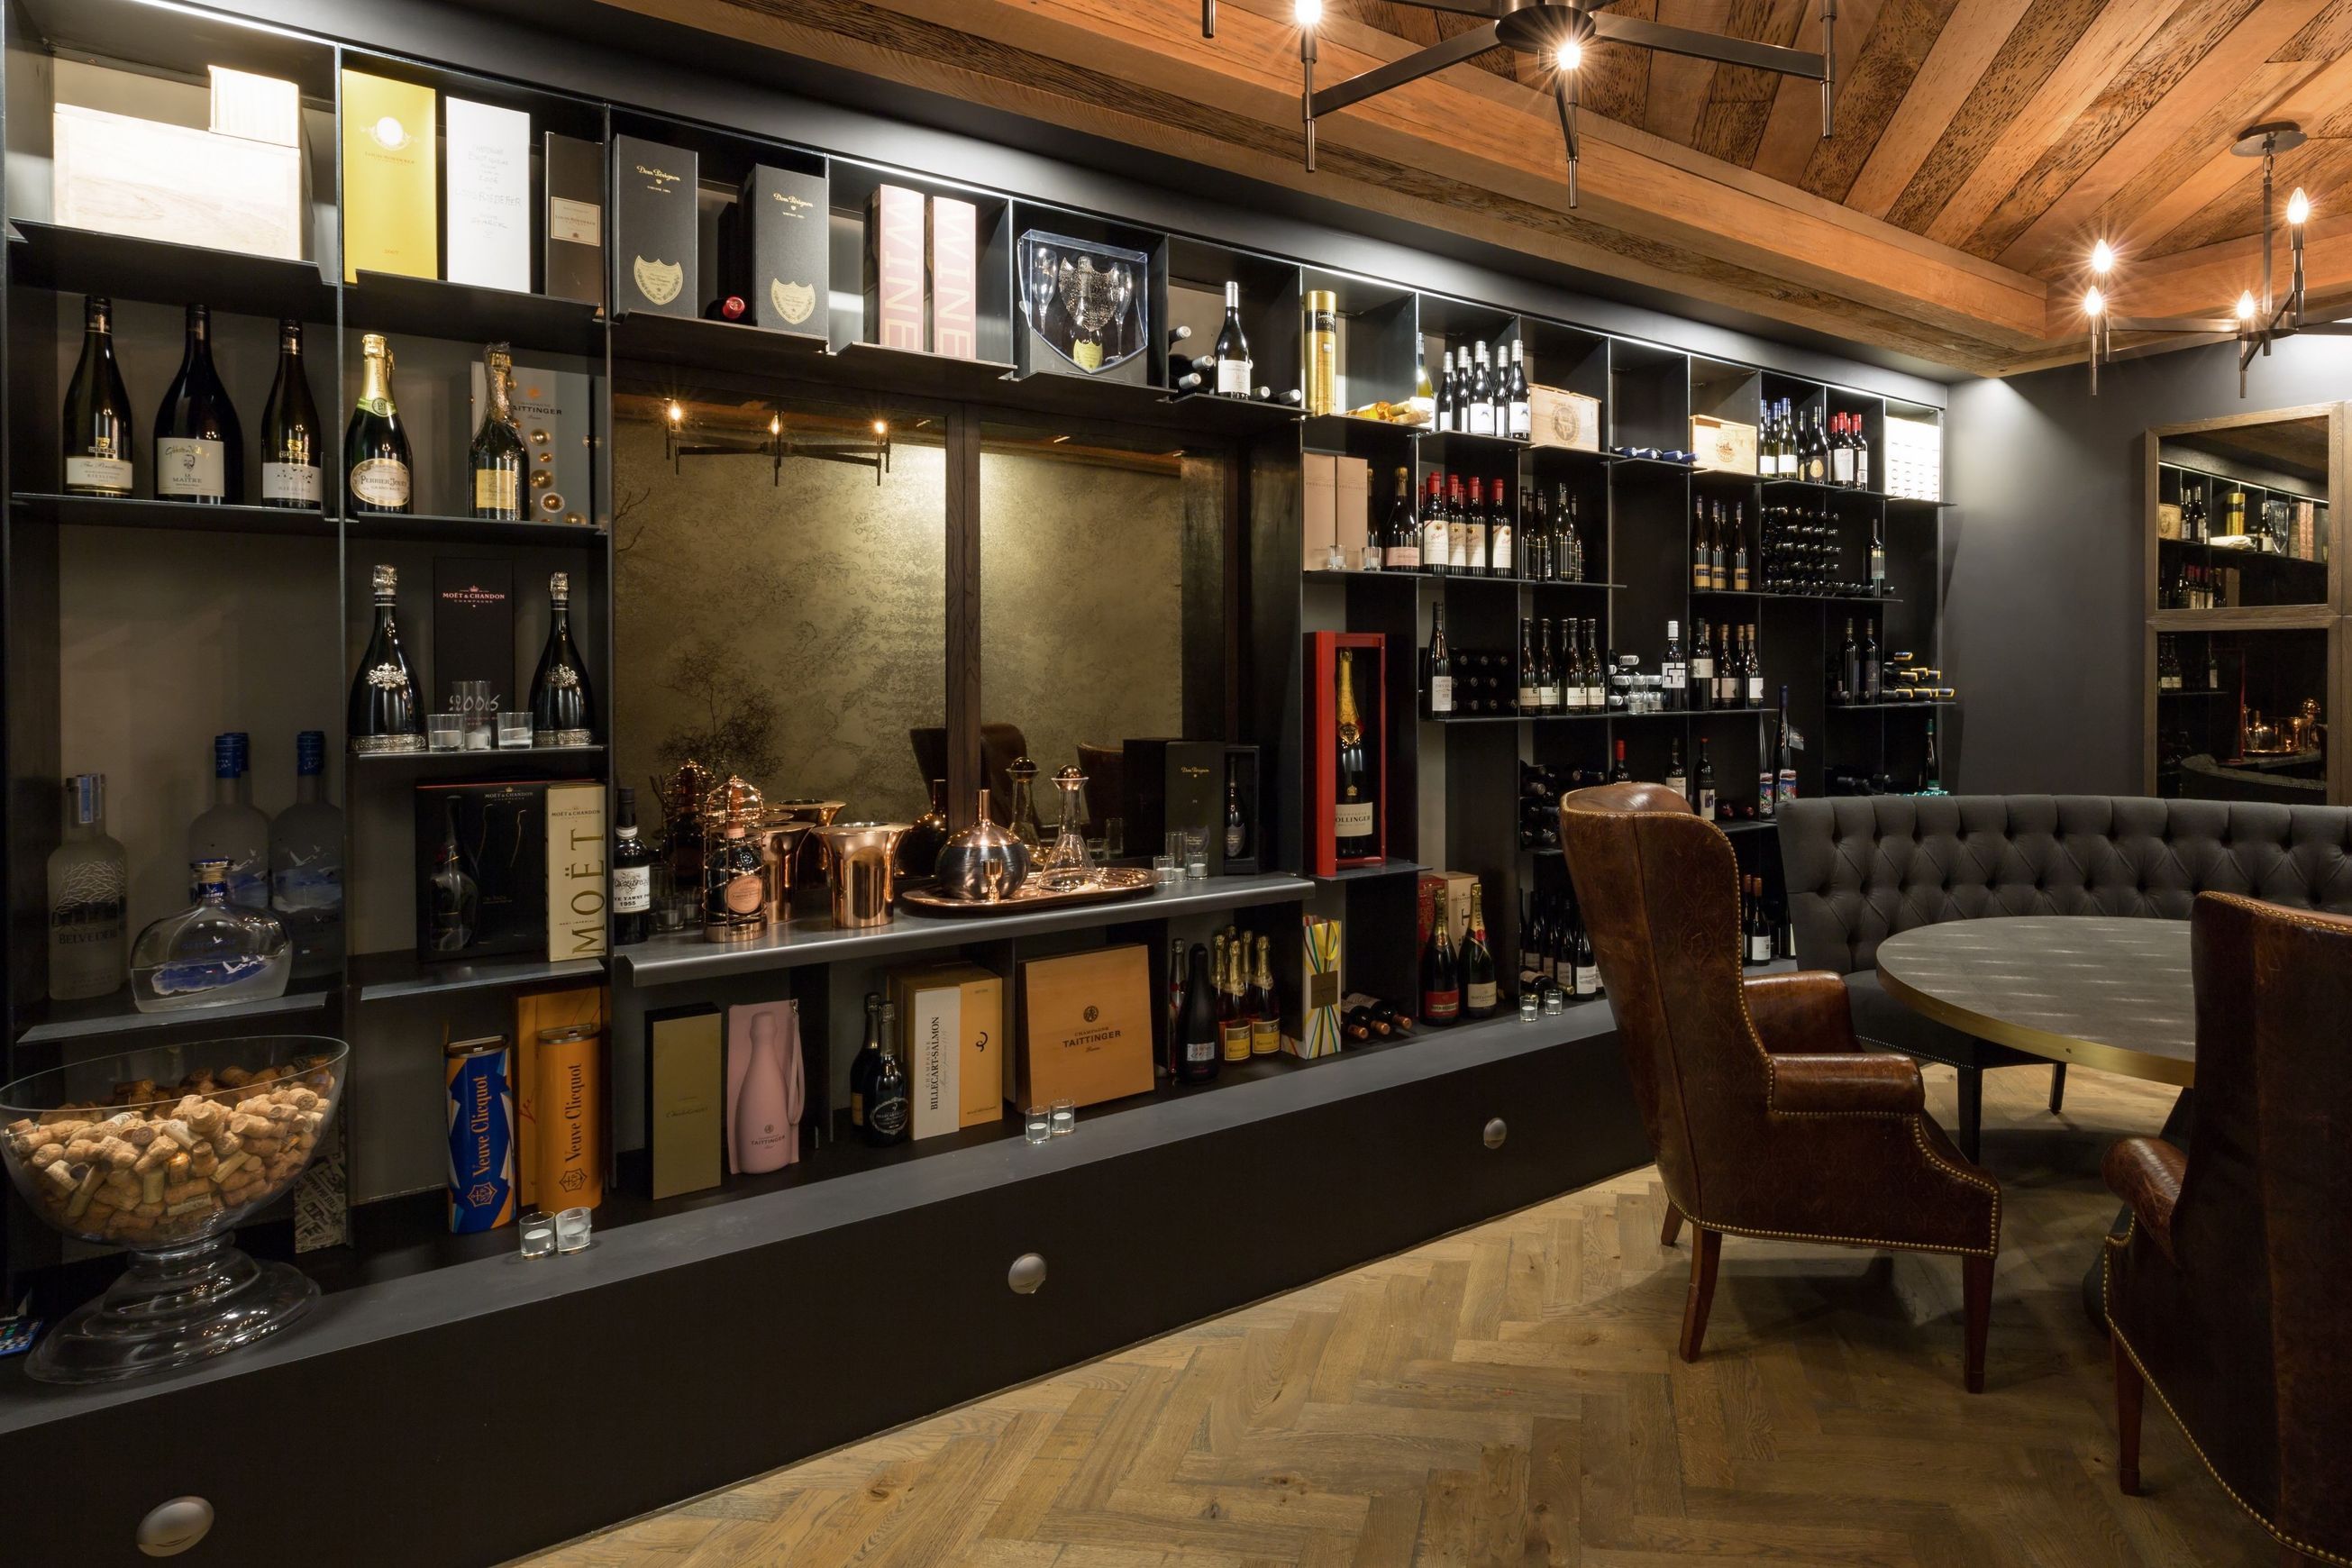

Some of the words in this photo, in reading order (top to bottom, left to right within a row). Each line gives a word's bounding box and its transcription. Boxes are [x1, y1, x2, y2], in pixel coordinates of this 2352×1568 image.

[884, 200, 919, 350] WINE
[937, 213, 971, 360] WINE
[512, 405, 562, 415] AITTINGER
[1335, 815, 1371, 823] OLLINGER
[564, 828, 606, 954] MOËT
[930, 1016, 940, 1111] BILLECART-SALMON
[1062, 1030, 1121, 1048] TAITTINGER
[469, 1073, 492, 1135] Clicquot
[564, 1062, 586, 1120] Clicquot
[471, 1134, 491, 1178] Veuve
[564, 1121, 582, 1163] Veuve
[749, 1135, 786, 1145] TAITTINGER
